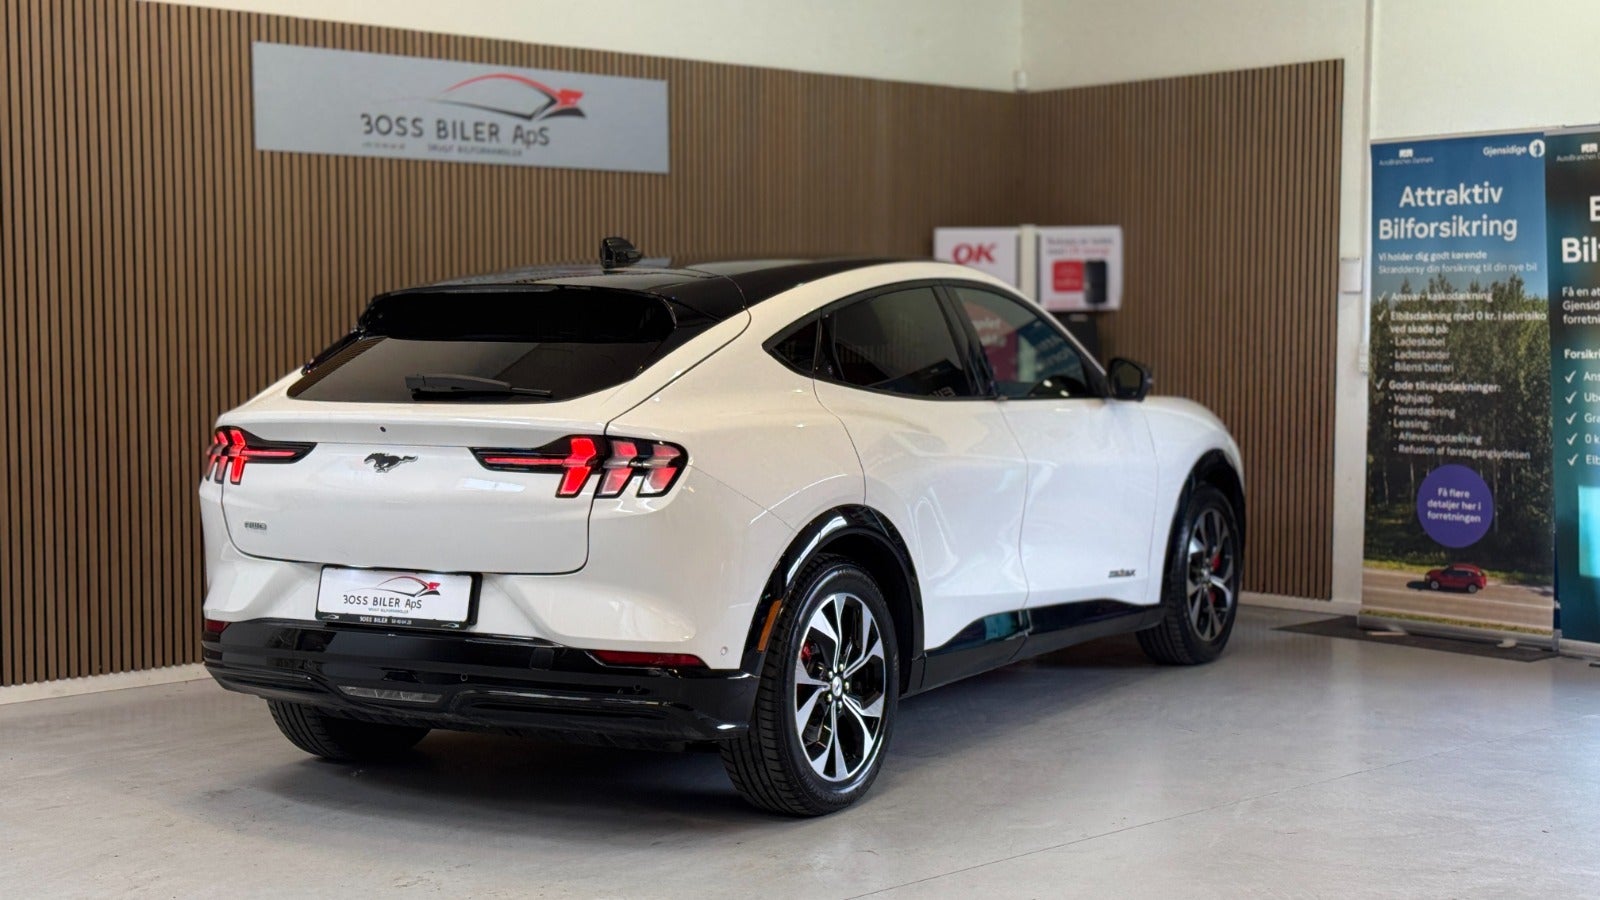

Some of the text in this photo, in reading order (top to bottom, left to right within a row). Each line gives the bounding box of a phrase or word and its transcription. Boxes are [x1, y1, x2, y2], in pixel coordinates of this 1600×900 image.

[436, 119, 500, 142] BILER
[512, 124, 550, 149] ApS
[1482, 146, 1528, 157] Gjensidige
[1399, 181, 1503, 208] Attraktiv
[1378, 214, 1518, 242] Bilforsikring
[952, 242, 996, 265] OK
[1562, 236, 1600, 264] Bil
[1378, 253, 1386, 262] Vi
[1388, 252, 1413, 262] holder
[1415, 252, 1429, 262] dig
[1430, 251, 1450, 262] godt
[1426, 265, 1440, 273] din
[1442, 264, 1480, 274] forsikring
[1483, 264, 1492, 272] til
[1494, 264, 1507, 272] din
[1508, 265, 1524, 274] nye
[1526, 263, 1537, 272] bil
[1562, 286, 1574, 297] Få
[1576, 288, 1588, 297] en
[1453, 312, 1474, 321] med
[1476, 312, 1483, 320] 0
[1502, 312, 1547, 321] selvrisiko
[1390, 326, 1406, 334] ved
[1408, 326, 1434, 334] skade
[1394, 338, 1446, 347] Ladeskabel
[1394, 350, 1450, 360] Ladestander
[1394, 364, 1454, 373] Bilens batteri
[1389, 382, 1414, 390] Gode
[1394, 418, 1429, 430] Leasing
[1584, 434, 1592, 444] 0
[1438, 488, 1470, 498] Få flere
[1427, 500, 1460, 510] detaljer
[1462, 502, 1476, 510] her
[1427, 511, 1482, 524] forretningen
[372, 596, 400, 608] BILER
[404, 598, 422, 610] ApS
